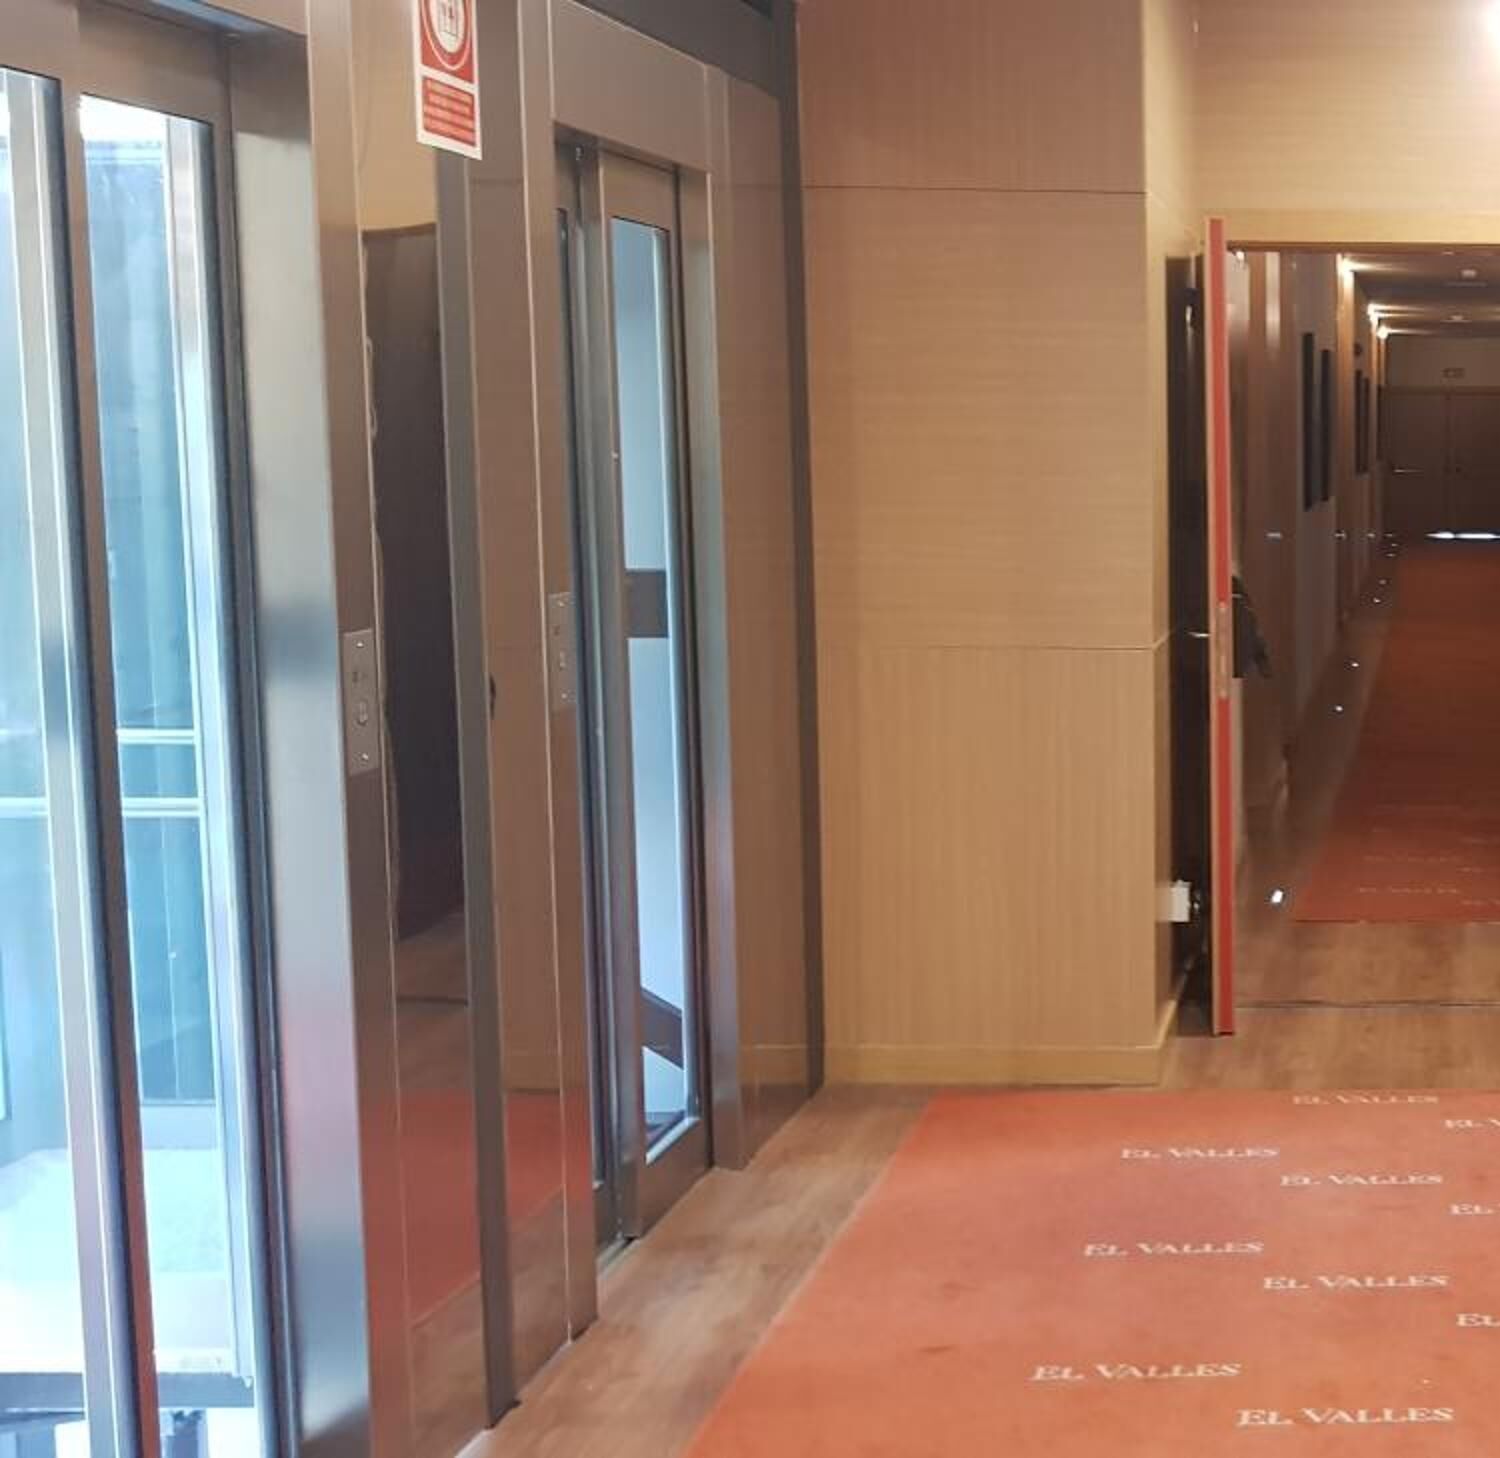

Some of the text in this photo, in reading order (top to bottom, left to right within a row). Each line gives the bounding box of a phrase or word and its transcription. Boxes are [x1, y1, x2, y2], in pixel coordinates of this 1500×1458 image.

[1445, 1118, 1483, 1128] EL
[1121, 1146, 1280, 1159] EL VALLES
[1280, 1172, 1444, 1186] EL VALLES
[1450, 1203, 1494, 1216] EL
[1084, 1241, 1265, 1257] EL VALLES
[1264, 1275, 1450, 1290] EL VALLES
[1029, 1362, 1242, 1382] EL VALLES
[1235, 1406, 1455, 1428] EL VALLES
